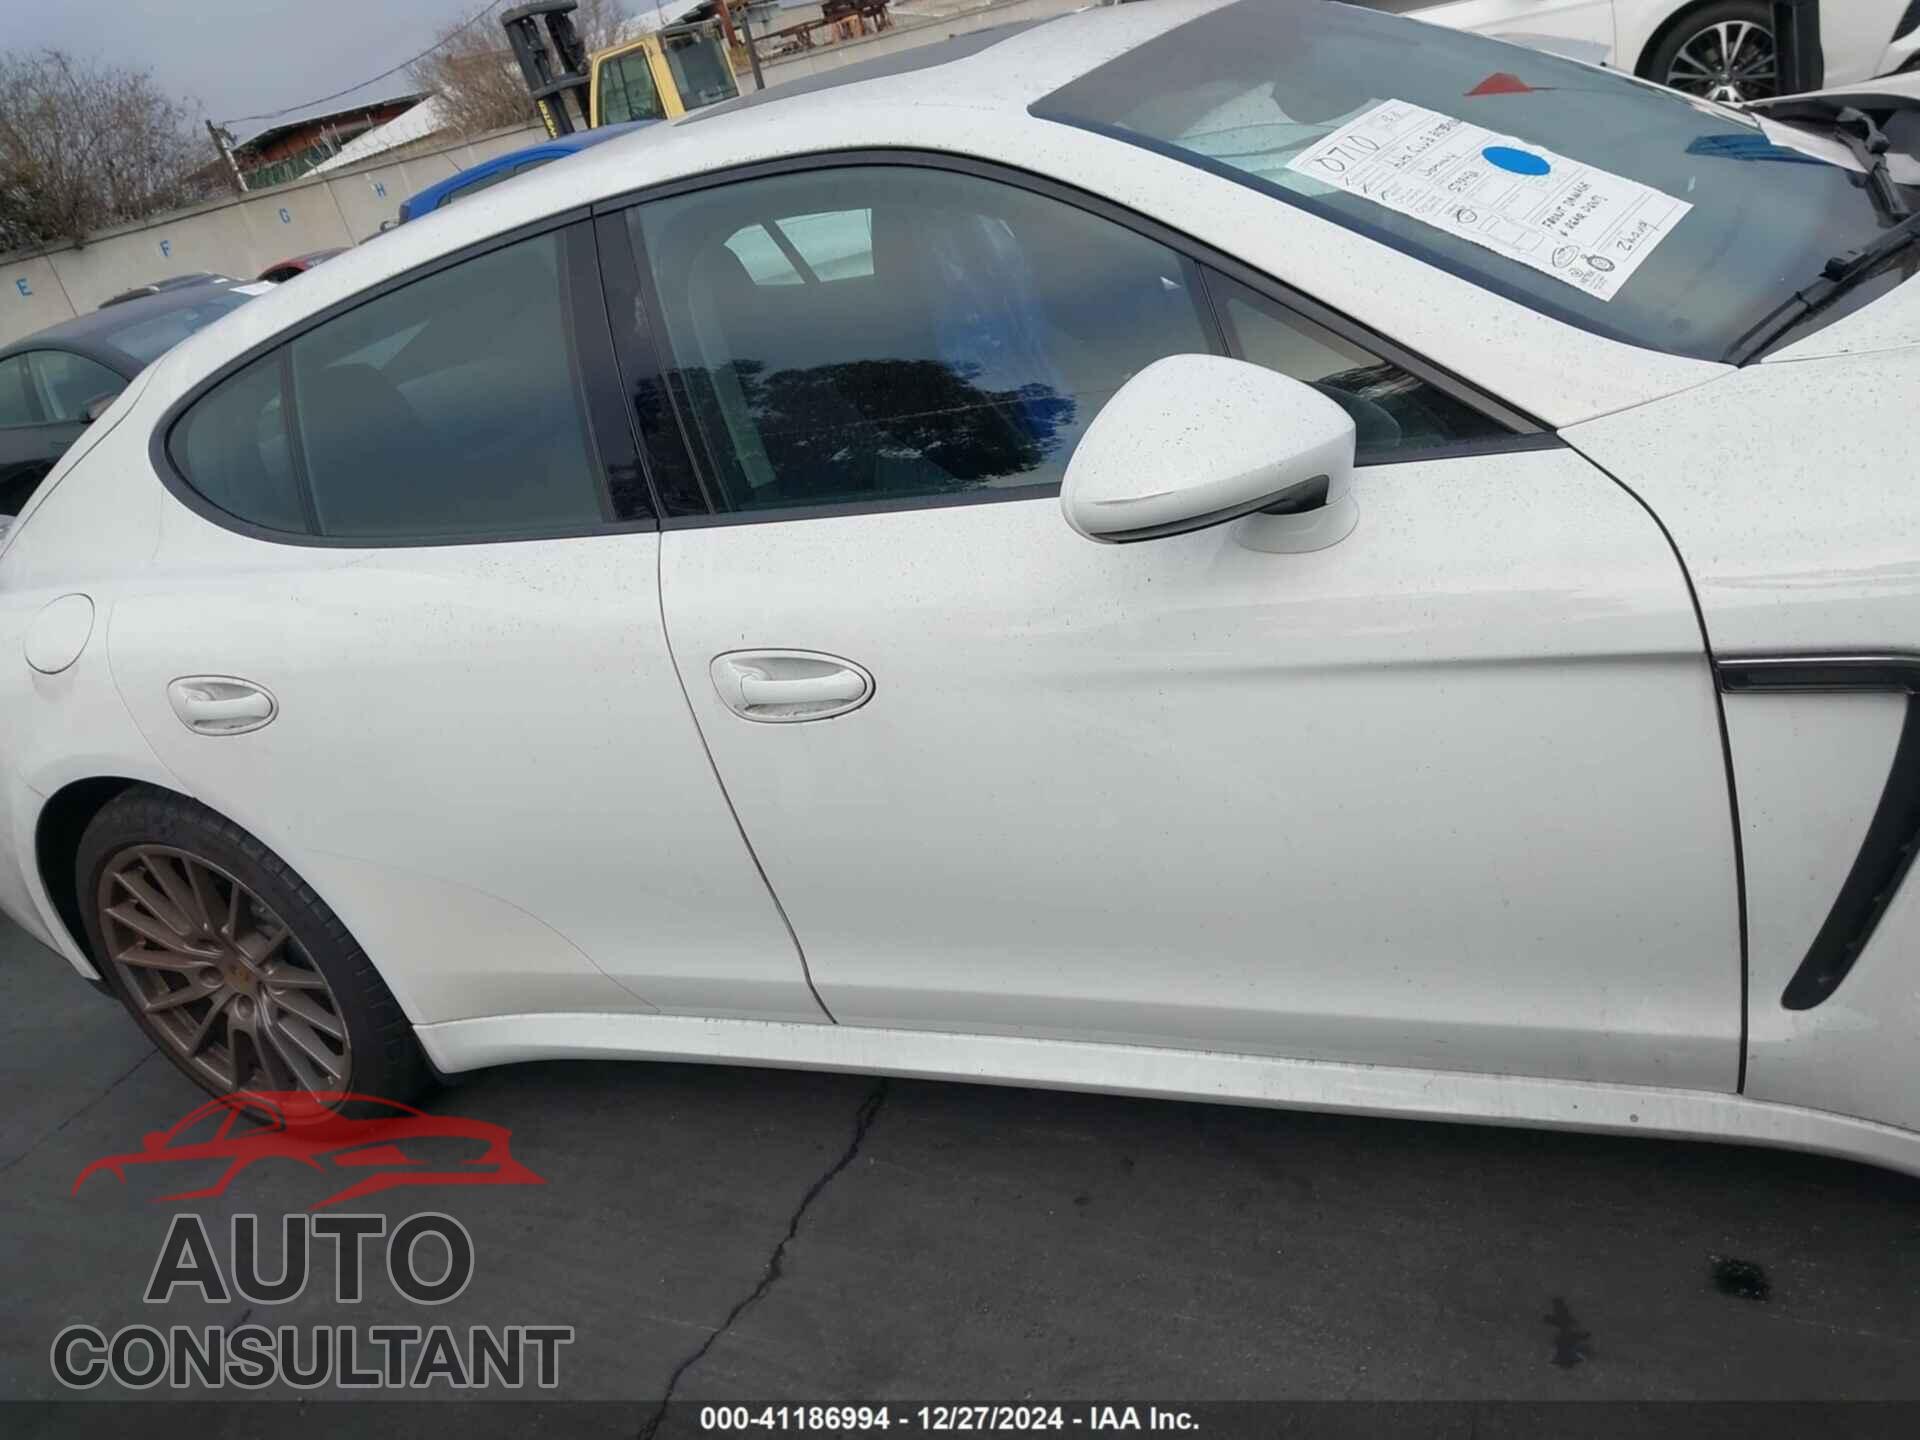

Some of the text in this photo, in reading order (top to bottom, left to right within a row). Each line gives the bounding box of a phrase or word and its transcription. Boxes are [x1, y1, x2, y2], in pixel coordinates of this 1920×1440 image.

[1313, 134, 1380, 173] 0710
[374, 182, 387, 198] H
[278, 207, 291, 225] G
[159, 239, 171, 257] F
[15, 277, 33, 297] E
